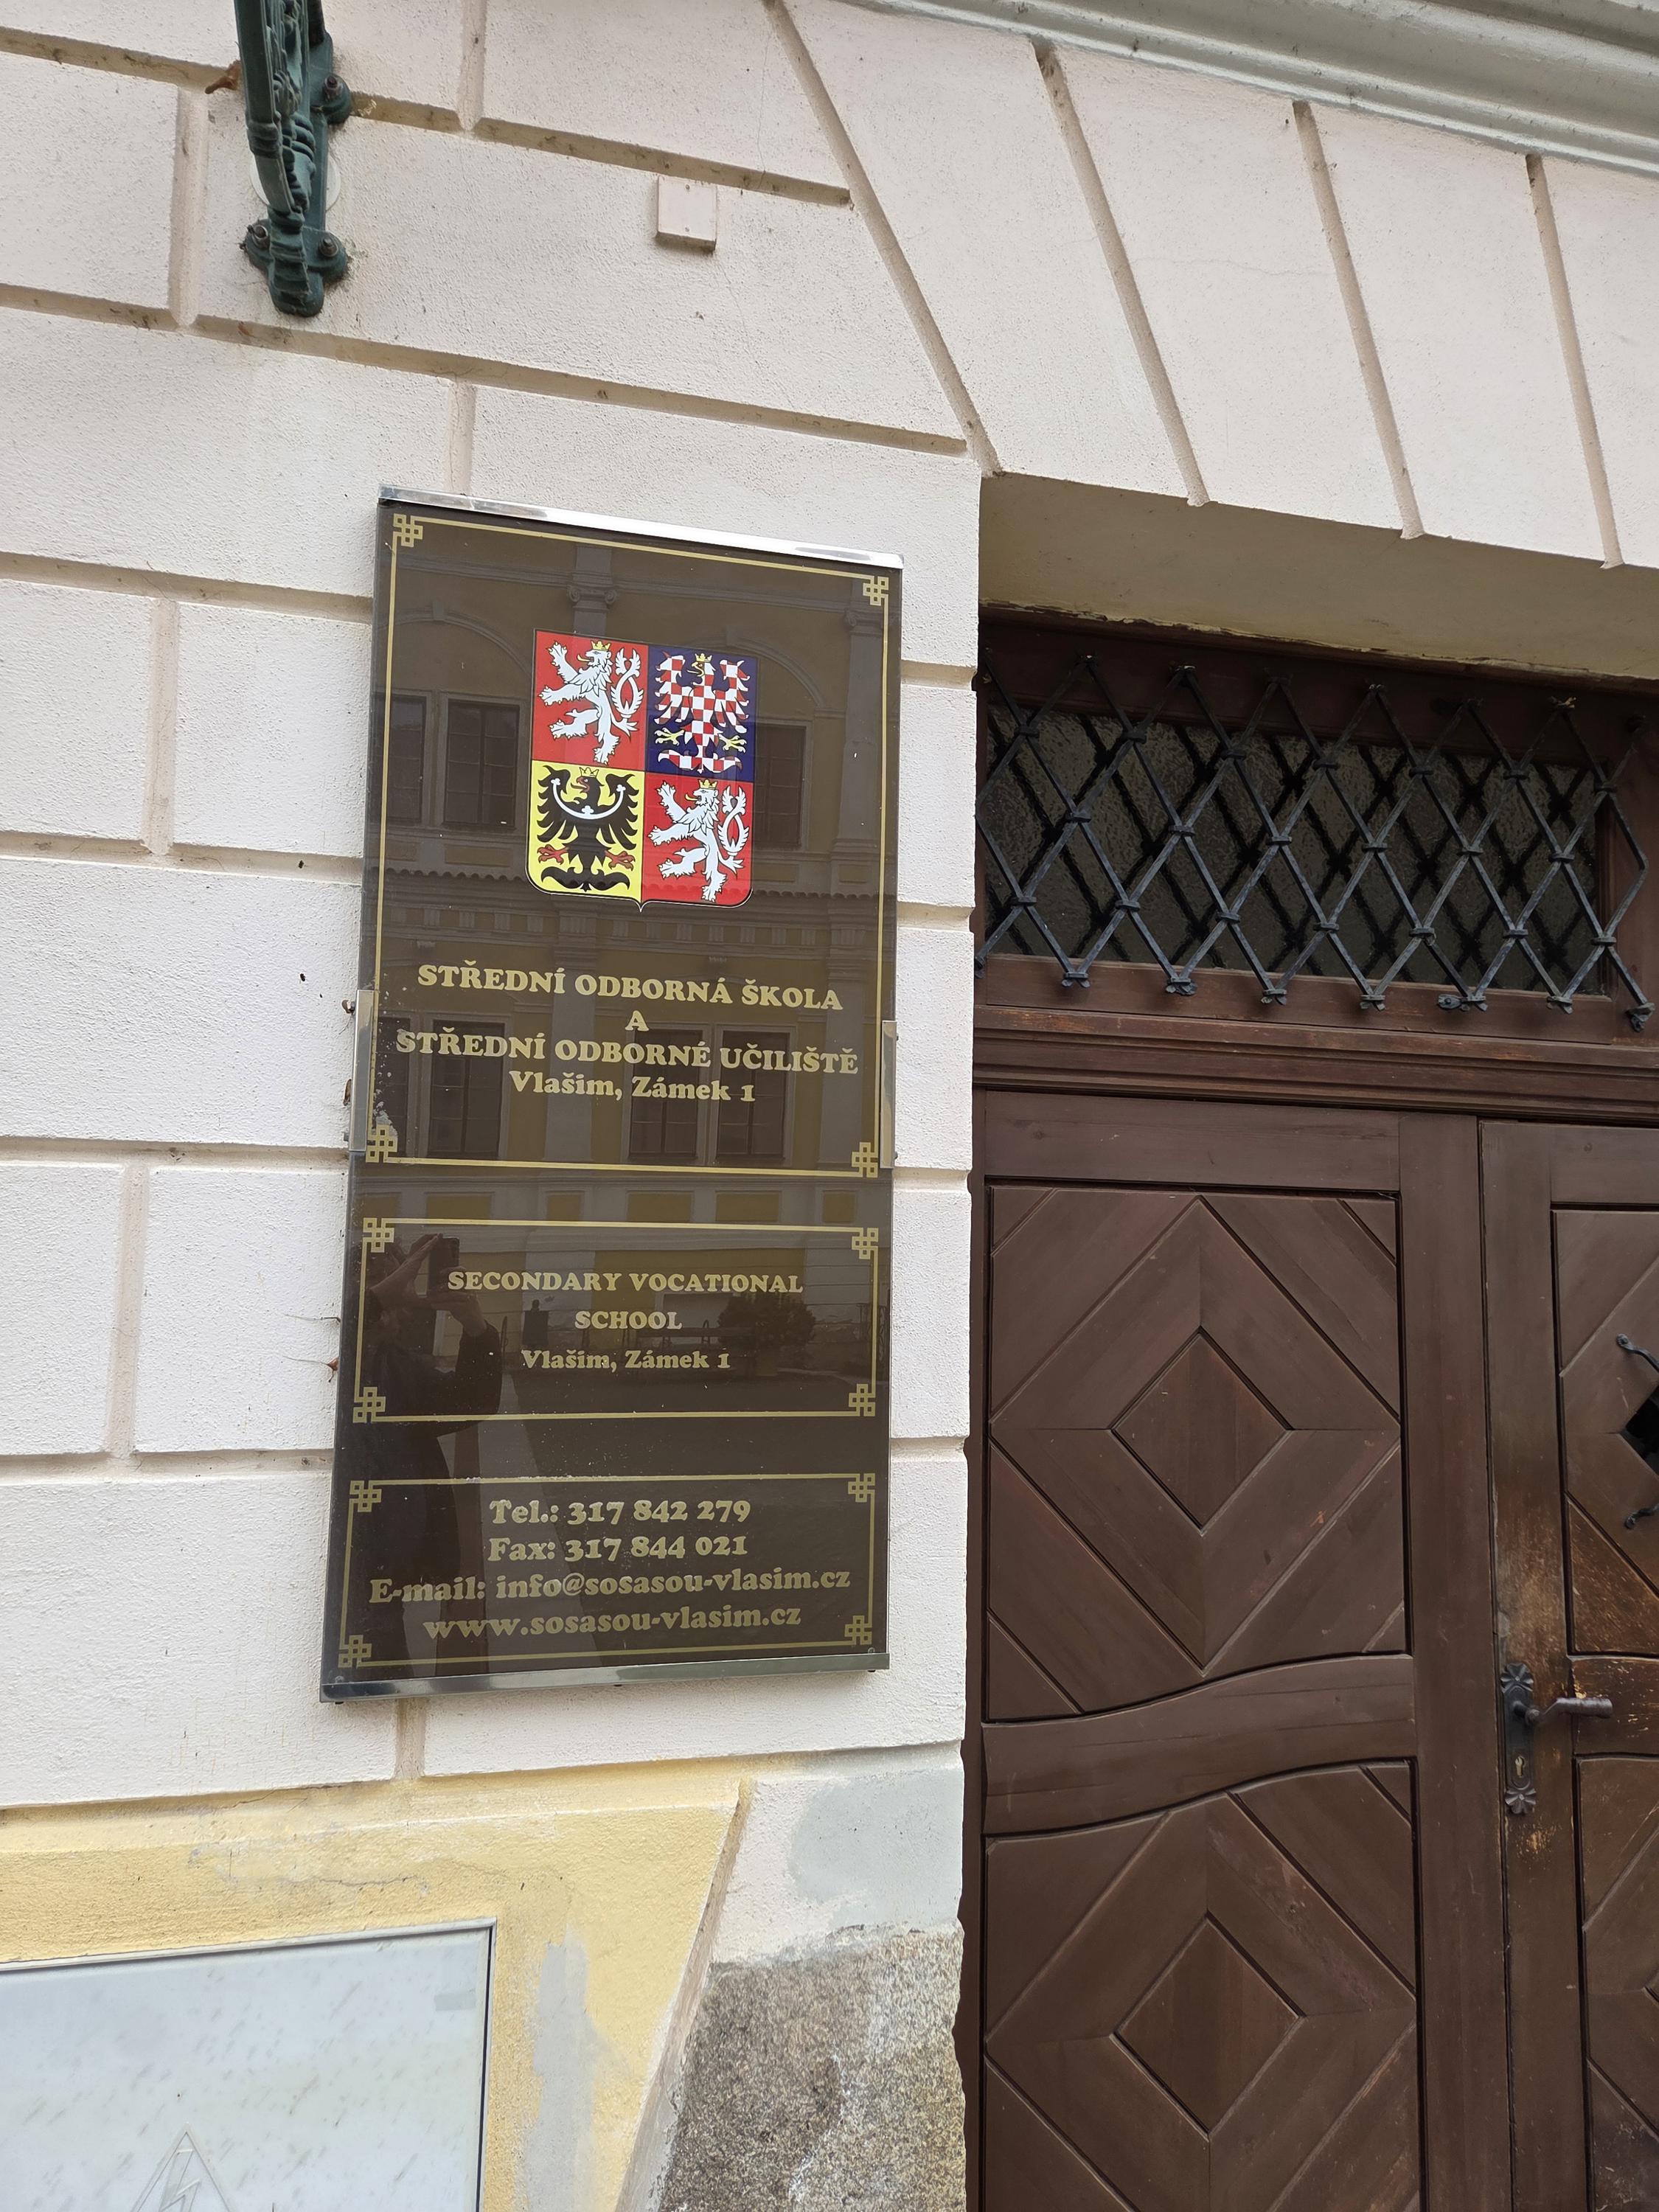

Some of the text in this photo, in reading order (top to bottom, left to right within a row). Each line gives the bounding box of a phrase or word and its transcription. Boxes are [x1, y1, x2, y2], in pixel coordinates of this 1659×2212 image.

[417, 960, 844, 1011] STŘEDNÍ ODBORNÁ ŠKOLA
[625, 1010, 650, 1032] A
[396, 1027, 859, 1074] STŘEDNÍ ODBORNÉ UČILIŠTĚ
[509, 1071, 756, 1102] Vlašim, Zámek 1
[447, 1271, 804, 1293] SECONDARY VOCATIONAL
[574, 1310, 683, 1331] SCHOOL
[521, 1349, 731, 1373] Vlašim, Zámek 1
[489, 1498, 751, 1525] Tel.: 317 842 279
[487, 1535, 748, 1562] Fax: 317 844 021
[368, 1567, 851, 1604] E-mail: info@sosasou-vlasim.cz
[423, 1604, 801, 1639] www.sosasou-vlasim.cz
